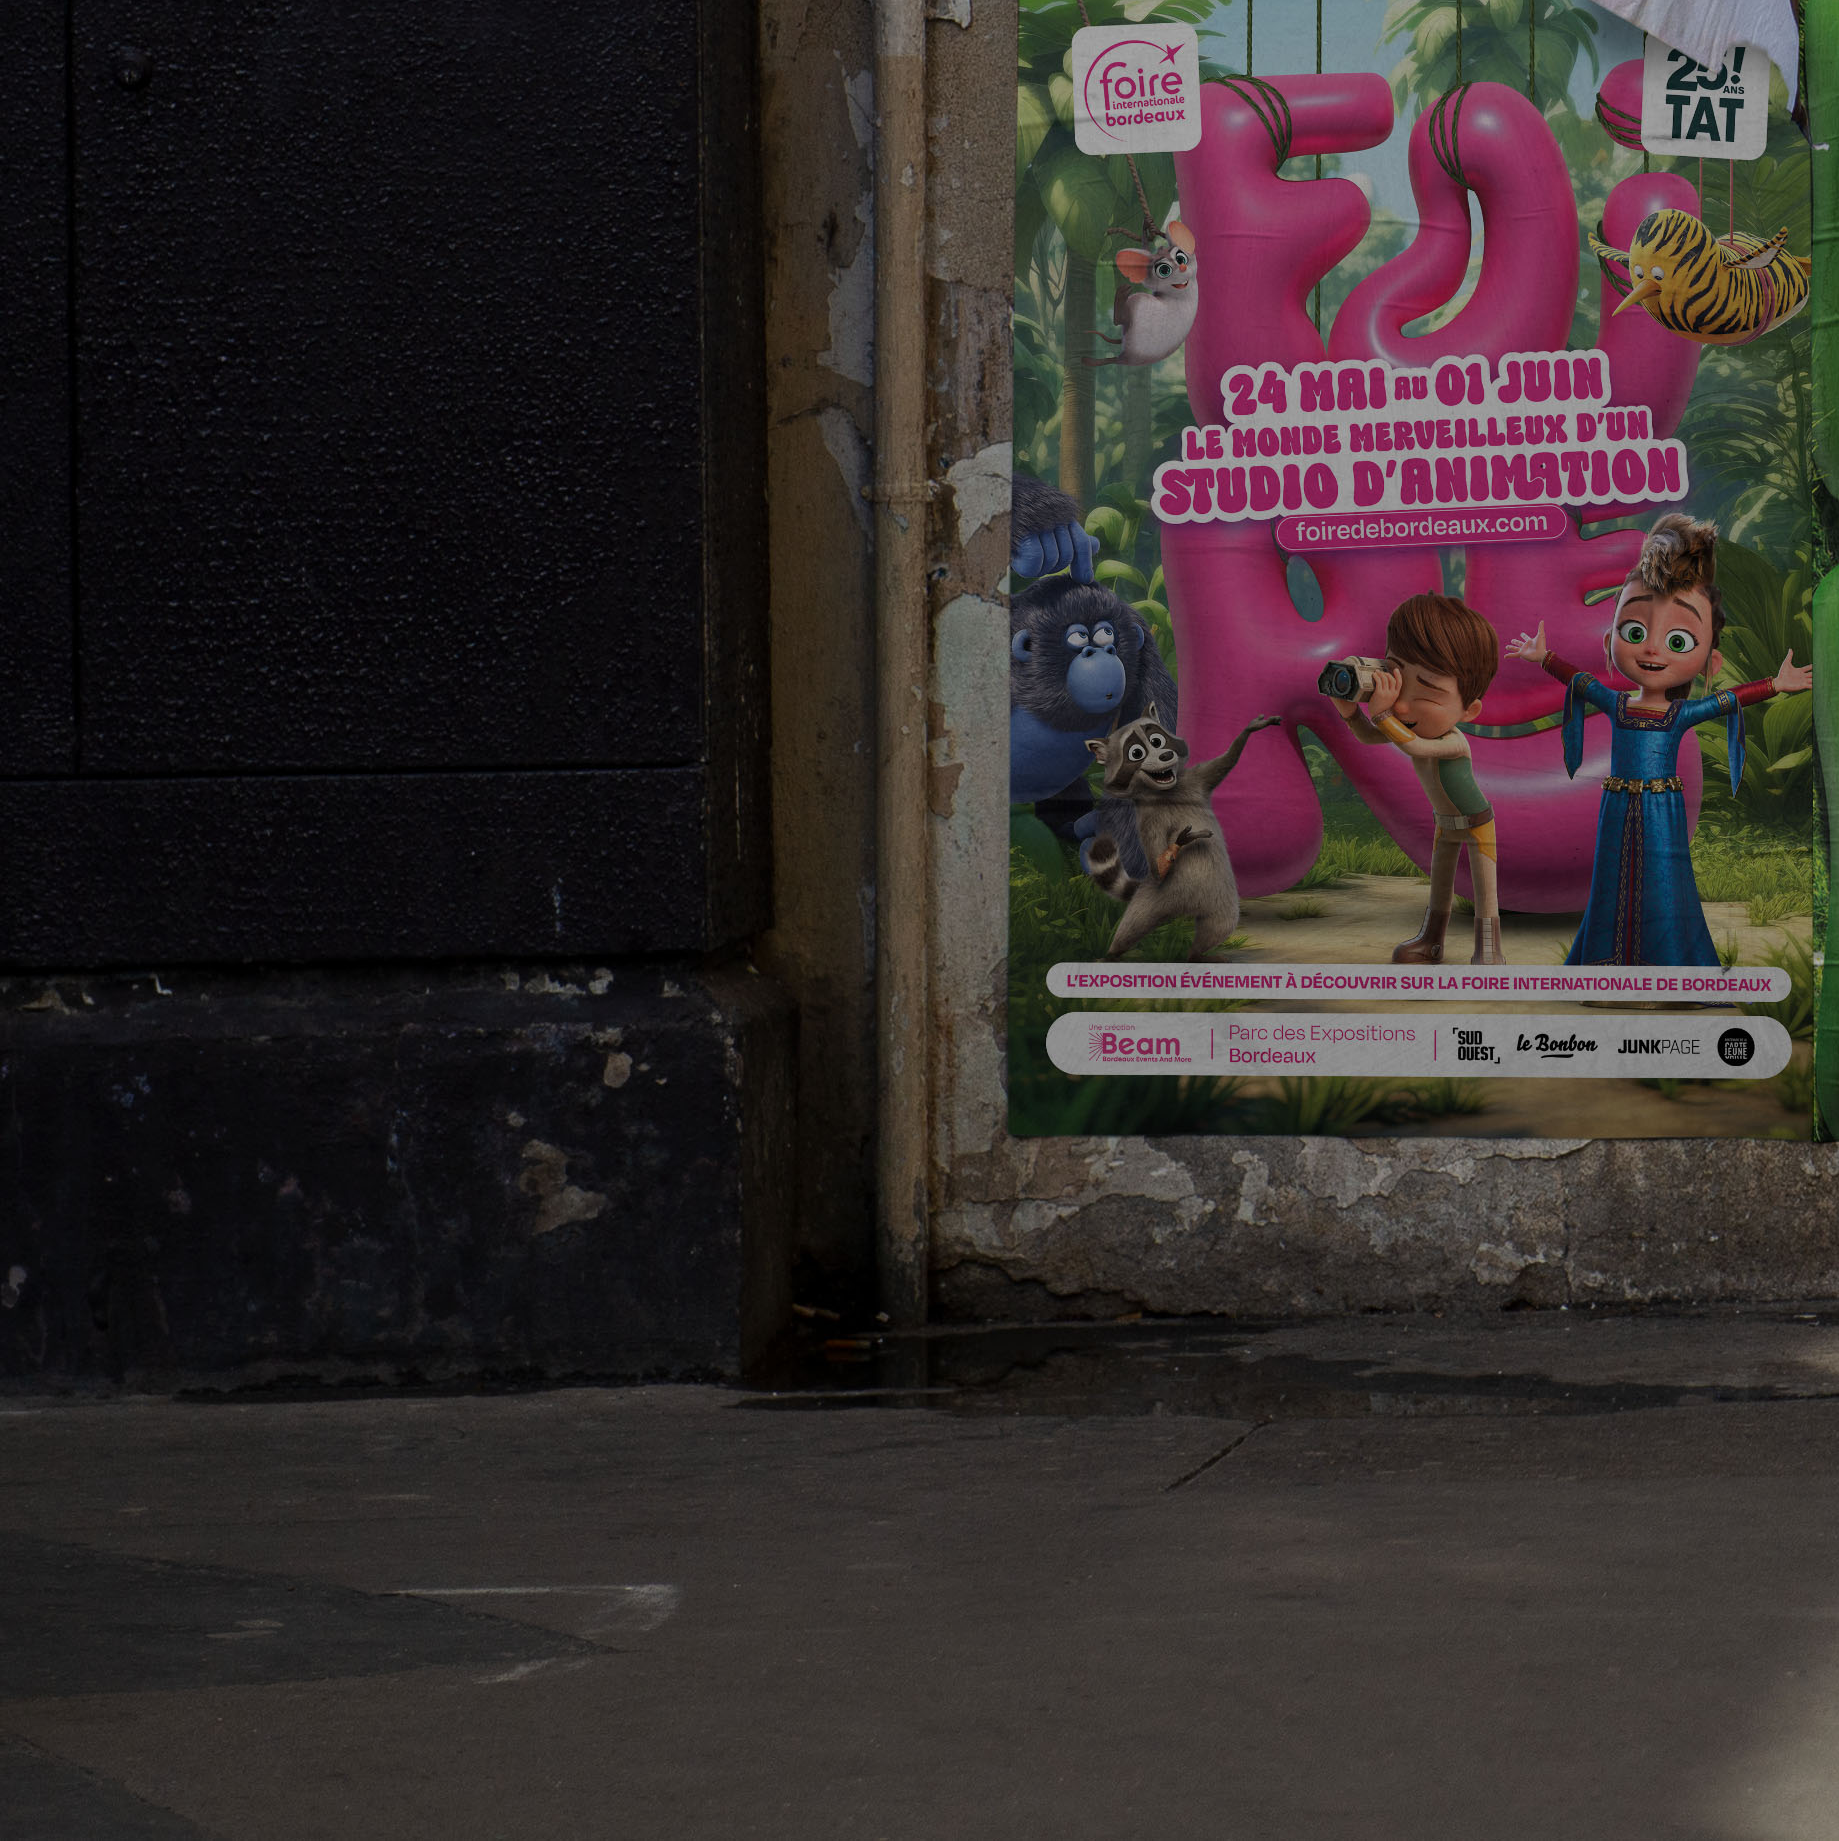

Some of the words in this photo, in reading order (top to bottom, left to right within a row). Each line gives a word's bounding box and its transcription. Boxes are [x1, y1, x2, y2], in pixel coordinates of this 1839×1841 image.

[1723, 86, 1744, 95] ANS
[1666, 94, 1744, 142] TAT
[1160, 463, 1338, 515] STUDIO
[1353, 447, 1680, 506] D'ANIMATION
[1230, 1025, 1267, 1040] Parc
[1273, 1025, 1305, 1040] des
[1311, 1026, 1415, 1043] Expositions
[1458, 1031, 1482, 1045] SUD
[1104, 1033, 1181, 1056] Beam
[1517, 1036, 1531, 1053] le
[1535, 1035, 1598, 1053] Bonbon
[1618, 1040, 1700, 1054] JUNKPAGE
[1230, 1048, 1315, 1063] Bordeaux
[1458, 1046, 1495, 1060] OUEST
